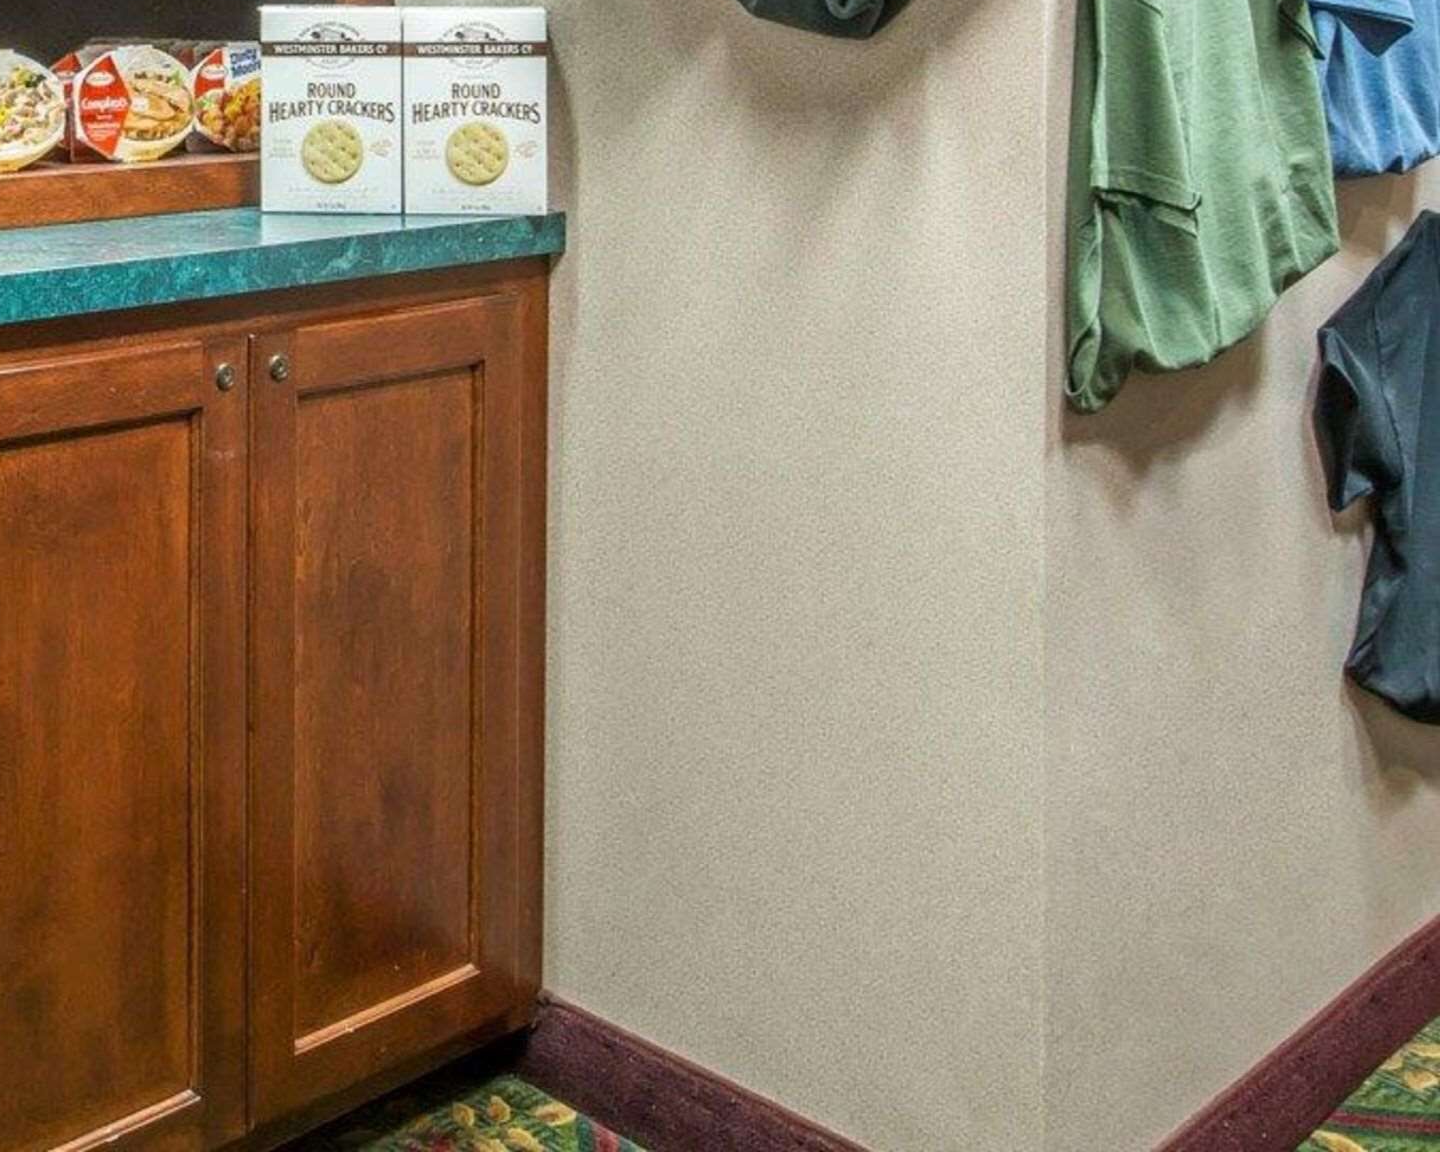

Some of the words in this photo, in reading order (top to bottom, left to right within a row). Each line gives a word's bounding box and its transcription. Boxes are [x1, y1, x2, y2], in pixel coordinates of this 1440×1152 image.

[273, 44, 338, 55] WESTMINSTER
[339, 44, 374, 55] BAKERS
[416, 44, 481, 55] WESTMINSTER
[483, 44, 518, 55] BAKERS
[307, 82, 357, 98] ROUND
[451, 82, 501, 98] ROUND
[268, 100, 324, 124] HEARTY
[326, 100, 396, 124] CRACKERS
[412, 101, 468, 125] HEARTY
[470, 100, 542, 125] CRACKERS
